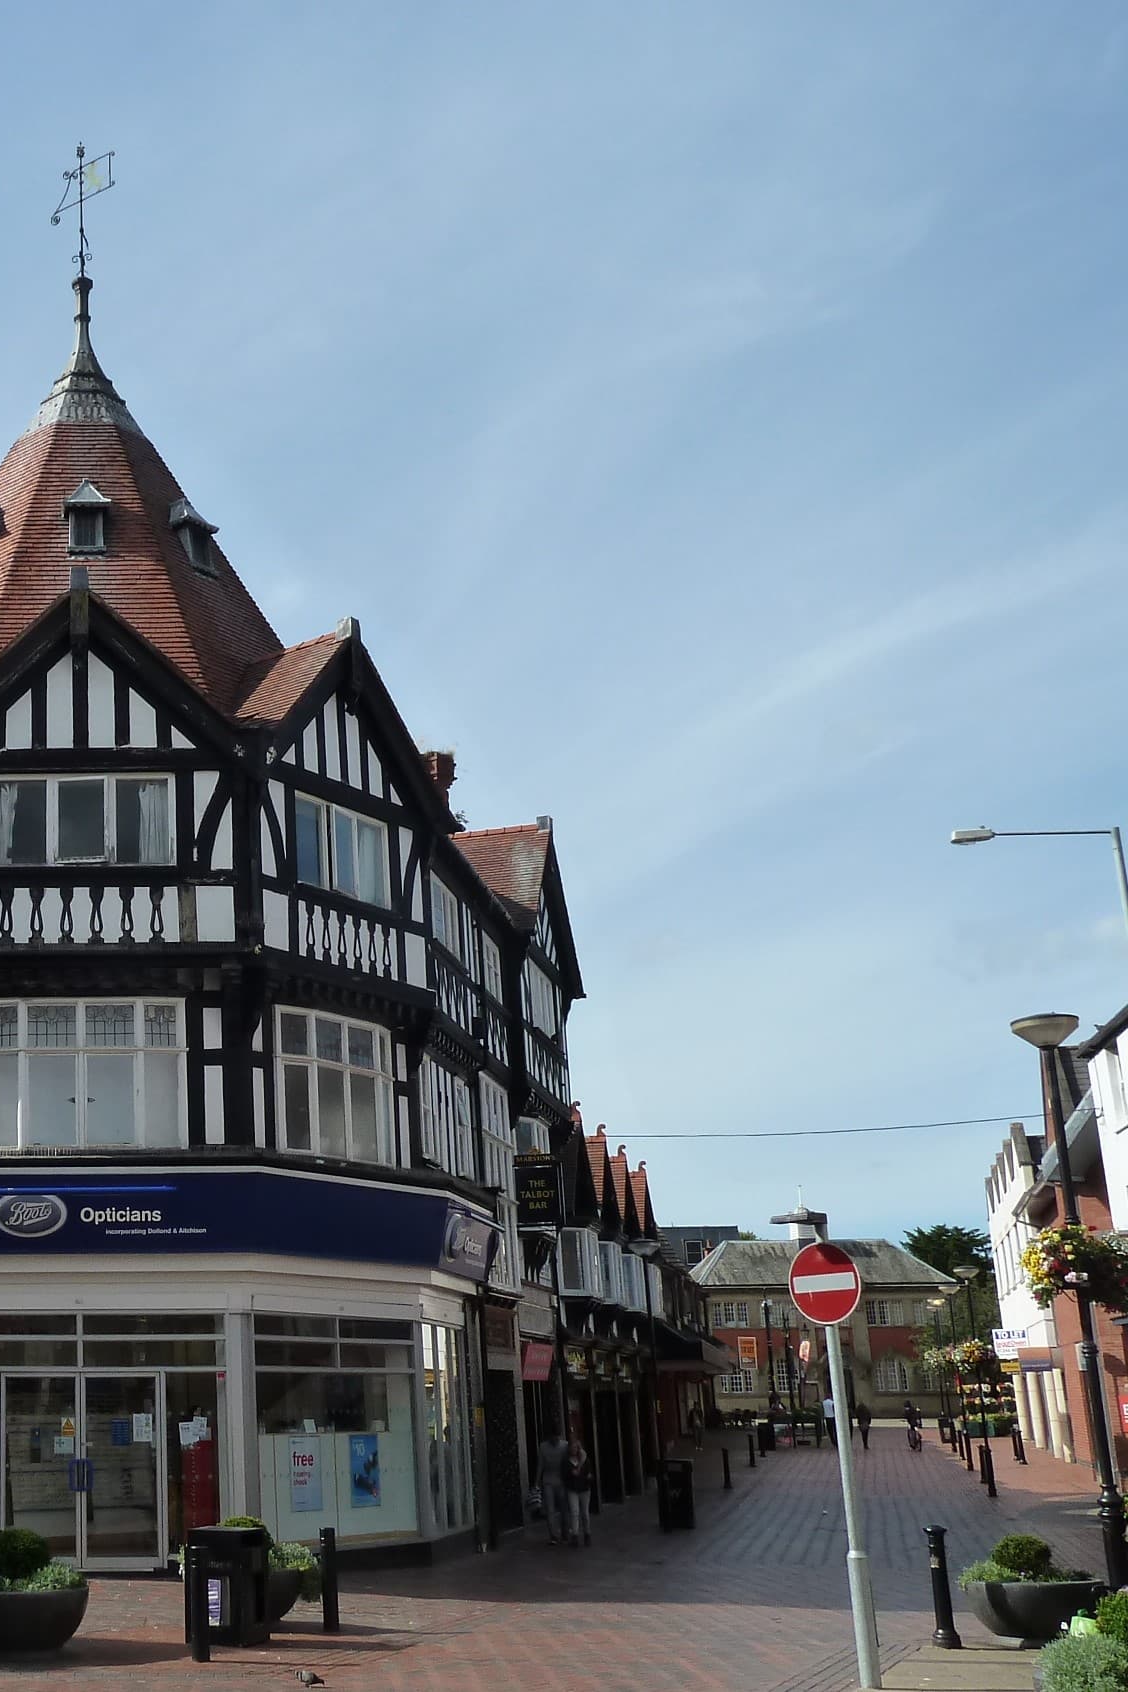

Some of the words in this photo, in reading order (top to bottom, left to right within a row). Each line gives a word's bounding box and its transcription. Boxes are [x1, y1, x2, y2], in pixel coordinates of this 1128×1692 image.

[528, 1179, 546, 1188] THE
[520, 1190, 555, 1199] TALBOT
[529, 1201, 547, 1210] BAR
[4, 1201, 53, 1226] Boots
[80, 1207, 162, 1225] Opticians
[105, 1228, 147, 1236] incorporating
[148, 1227, 172, 1235] Dollond
[292, 1451, 314, 1466] free
